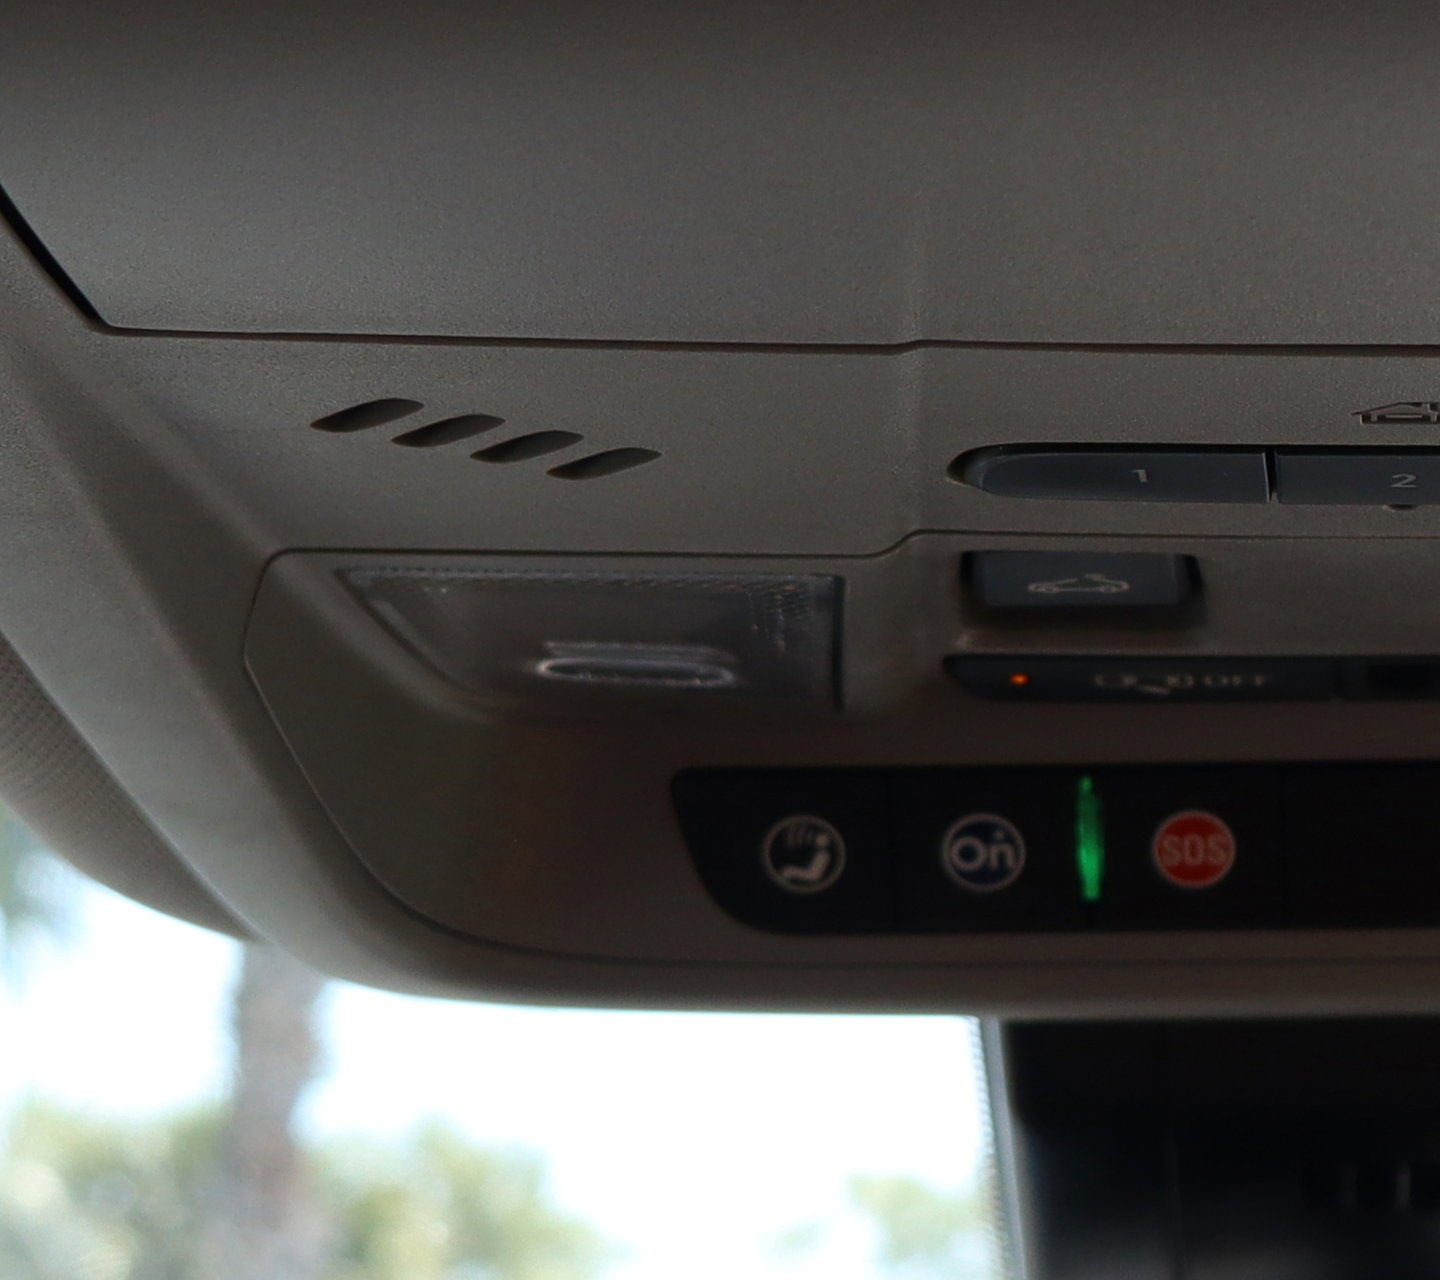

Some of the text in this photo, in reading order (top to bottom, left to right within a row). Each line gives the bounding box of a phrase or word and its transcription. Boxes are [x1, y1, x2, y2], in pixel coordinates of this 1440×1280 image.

[1131, 469, 1149, 484] 1
[1390, 474, 1418, 489] 2
[1159, 832, 1229, 867] SOS
